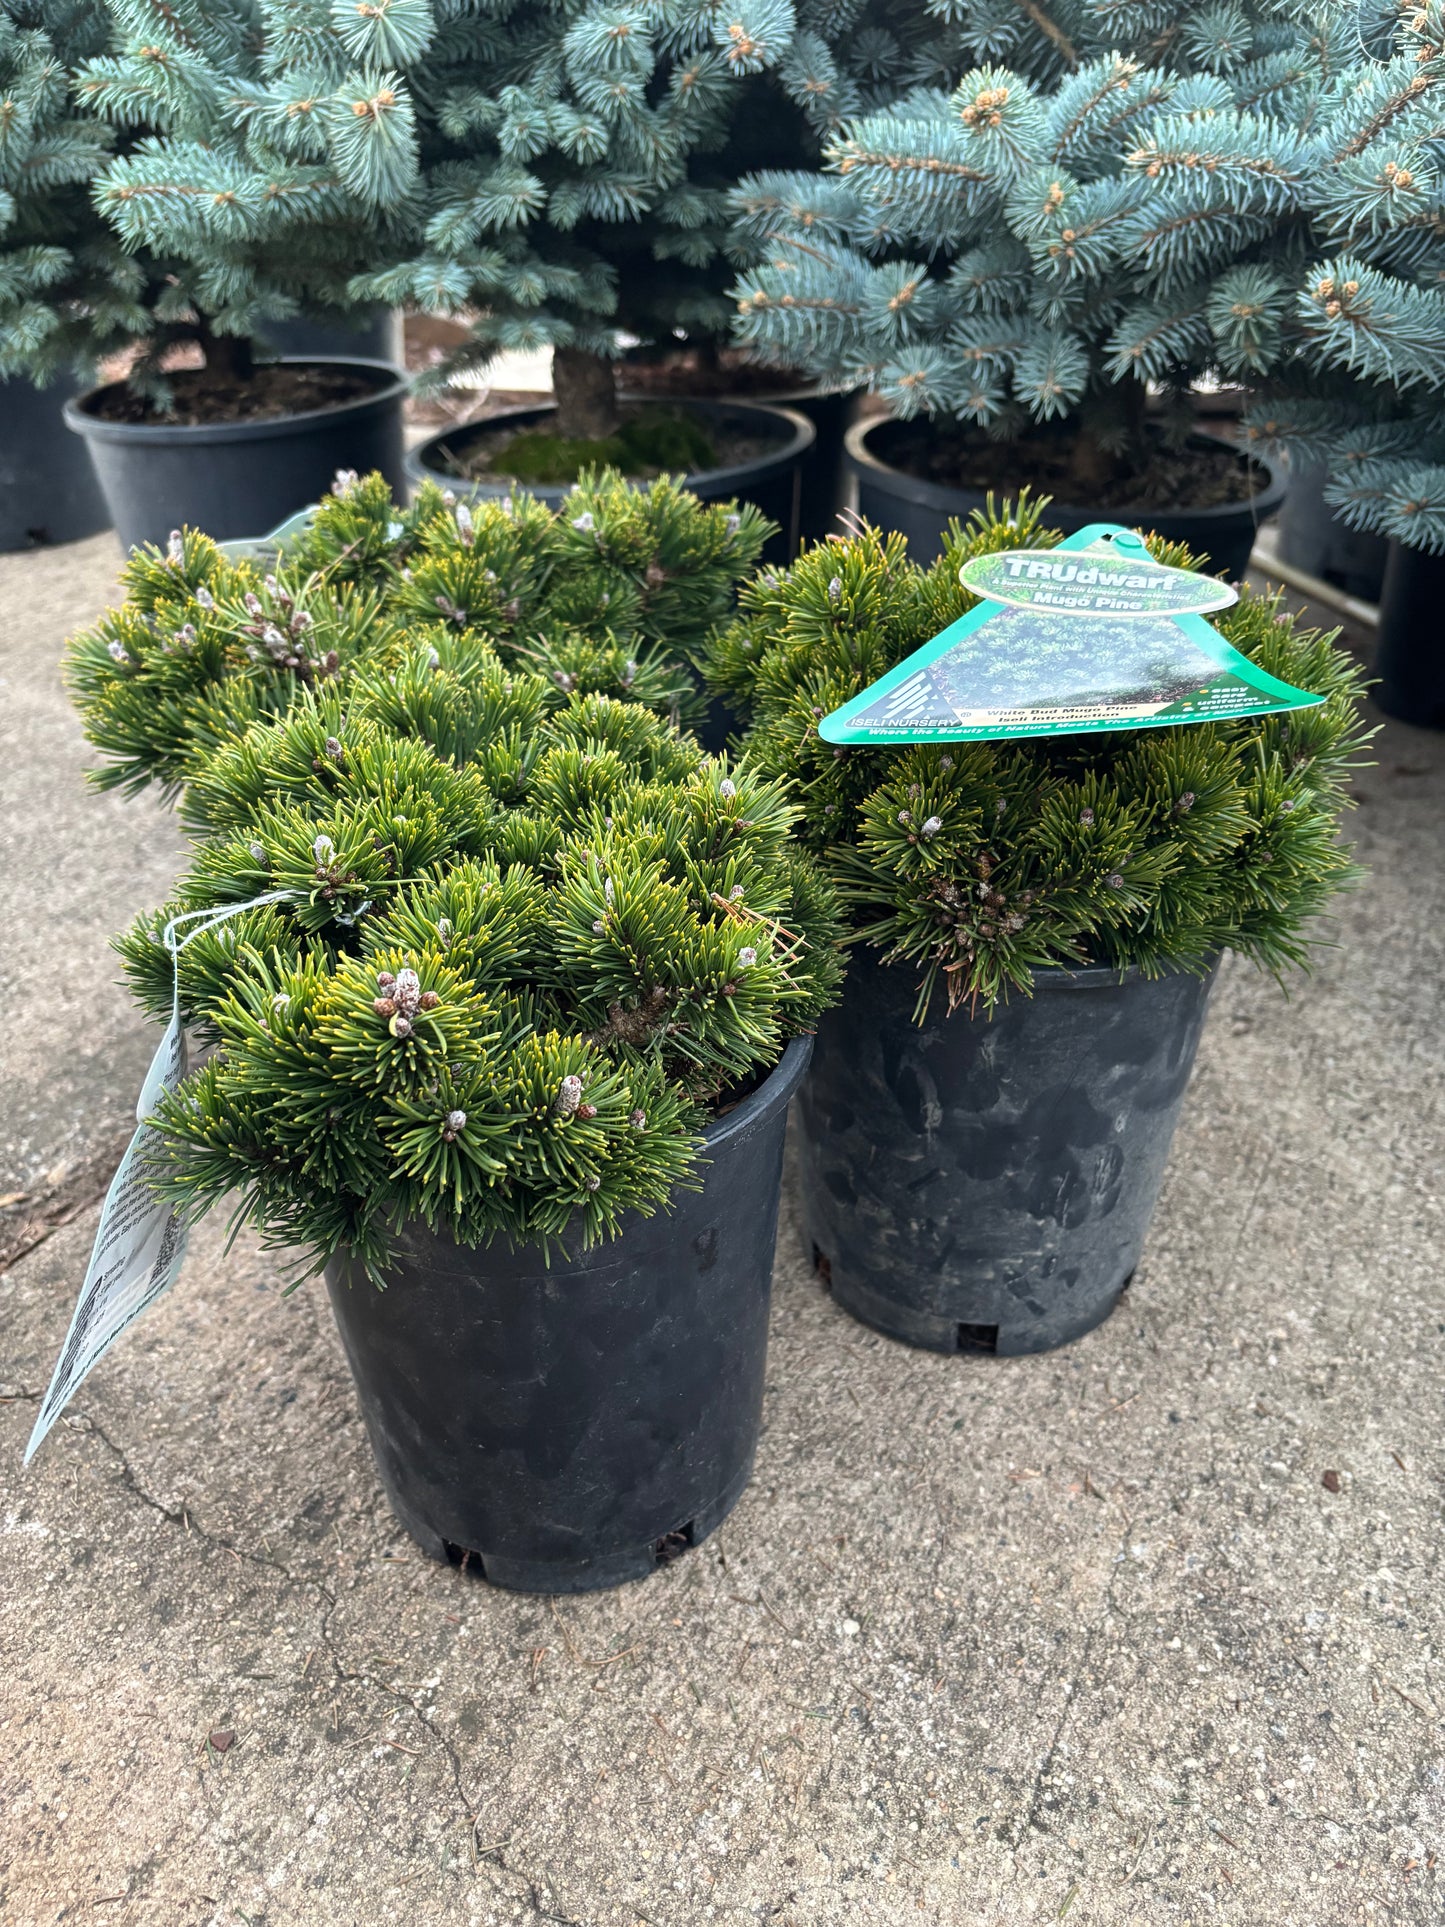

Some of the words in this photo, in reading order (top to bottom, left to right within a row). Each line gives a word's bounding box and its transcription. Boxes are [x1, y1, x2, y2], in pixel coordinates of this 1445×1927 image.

[1006, 557, 1177, 590] TRUdwarf
[1040, 582, 1063, 591] Plant
[1065, 584, 1084, 593] with
[1087, 586, 1119, 596] Unique
[1033, 591, 1090, 608] Mugo
[1095, 596, 1142, 610] Pine
[1197, 697, 1258, 706] uniform
[851, 718, 885, 727] ISELI
[888, 718, 958, 727] NURSERY
[1032, 712, 1119, 721] Introduction
[869, 727, 909, 735] Where
[912, 727, 934, 735] the
[937, 726, 984, 735] Beauty
[1005, 724, 1052, 732] Nature
[1056, 720, 1098, 728] Meets
[1134, 713, 1190, 723] Artistry
